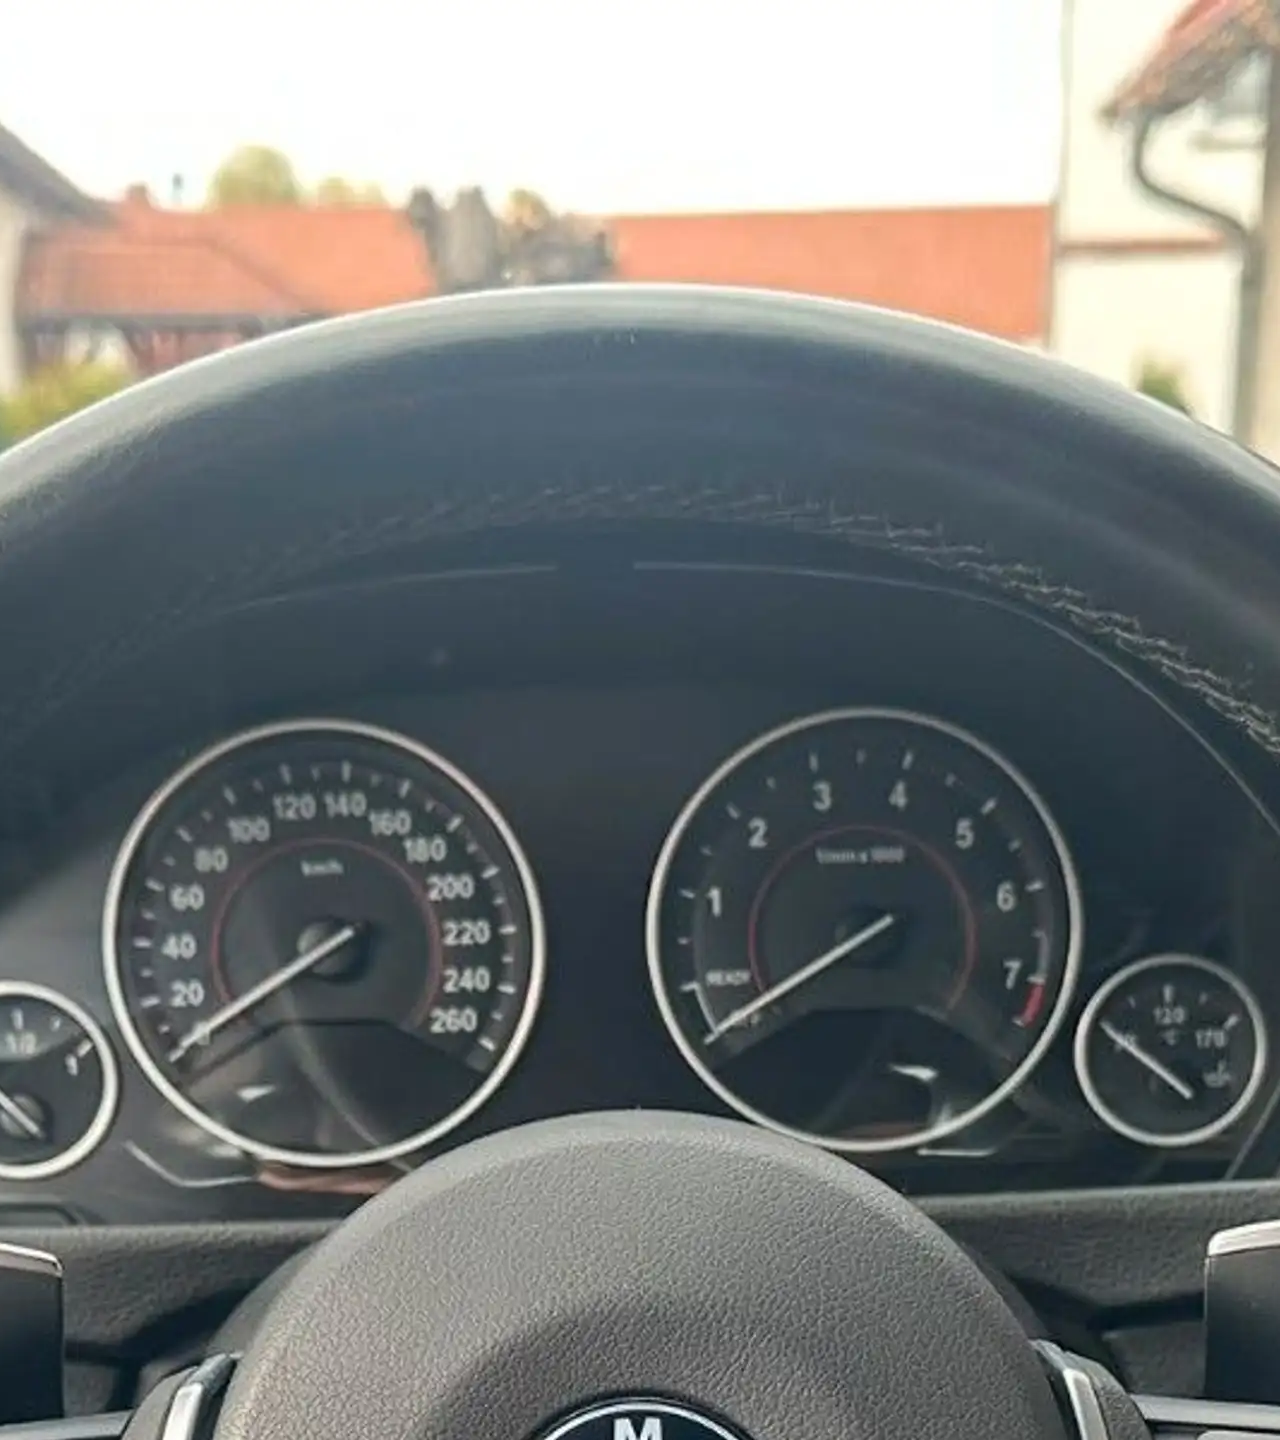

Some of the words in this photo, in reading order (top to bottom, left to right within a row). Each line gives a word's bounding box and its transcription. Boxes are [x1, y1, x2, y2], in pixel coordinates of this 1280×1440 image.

[273, 794, 317, 819] 120
[324, 792, 368, 817] 140
[813, 781, 832, 811] 3
[888, 780, 908, 810] 4
[228, 817, 271, 843] 100
[368, 809, 412, 837] 160
[748, 818, 768, 848] 2
[956, 819, 975, 849] 5
[194, 848, 228, 872] 80
[405, 837, 447, 862] 180
[170, 885, 205, 910] 60
[427, 874, 474, 900] 200
[996, 882, 1016, 912] 6
[705, 886, 721, 918] 1
[443, 920, 491, 945] 220
[161, 933, 197, 959] 40
[443, 967, 491, 993] 240
[1003, 960, 1022, 989] 7
[170, 982, 204, 1008] 20
[429, 1009, 478, 1034] 260
